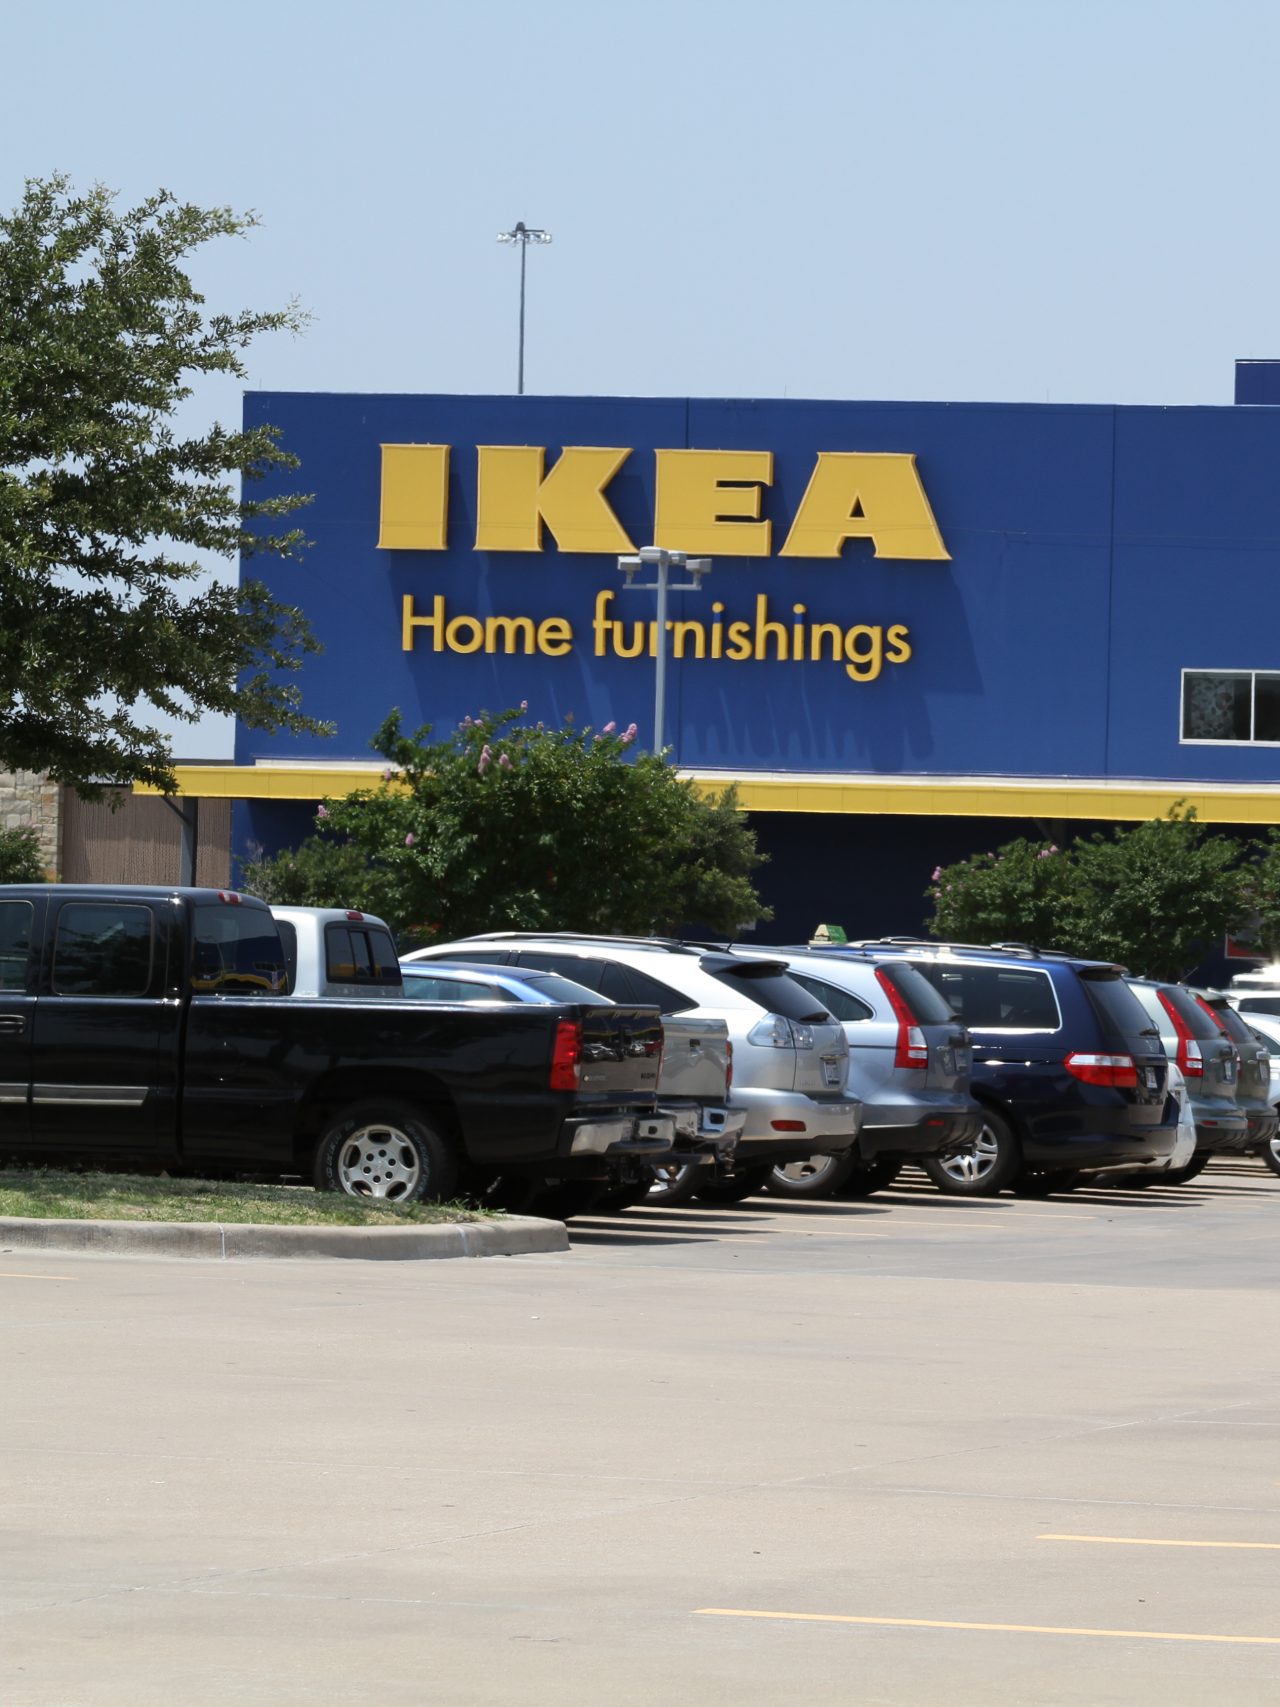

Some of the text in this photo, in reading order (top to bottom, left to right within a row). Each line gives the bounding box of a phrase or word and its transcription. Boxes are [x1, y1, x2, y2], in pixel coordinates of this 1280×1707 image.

[376, 443, 953, 561] IKEA
[401, 589, 912, 682] Home furnishings
